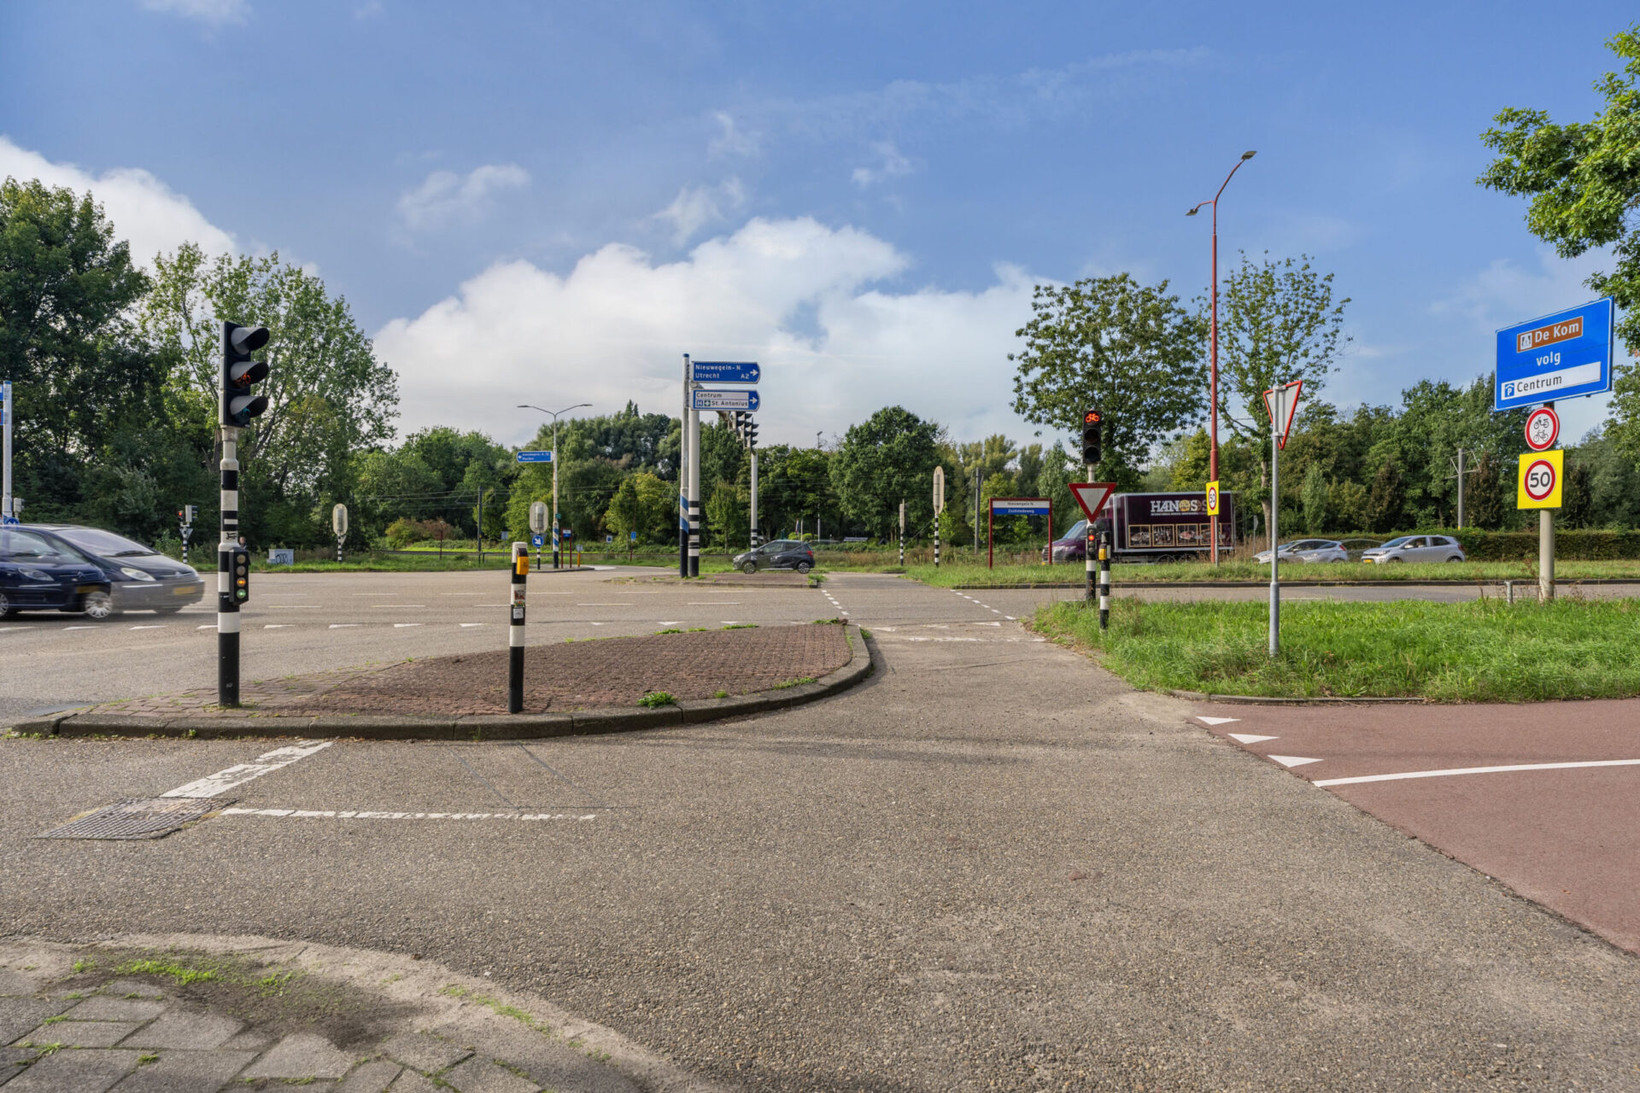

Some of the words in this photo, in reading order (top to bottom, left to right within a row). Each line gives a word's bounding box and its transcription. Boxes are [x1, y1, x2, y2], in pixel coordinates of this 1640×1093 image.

[1534, 330, 1549, 343] De
[1553, 322, 1580, 338] Kom
[1536, 351, 1561, 366] volg
[1516, 375, 1562, 393] Centrum
[1530, 471, 1551, 488] 50
